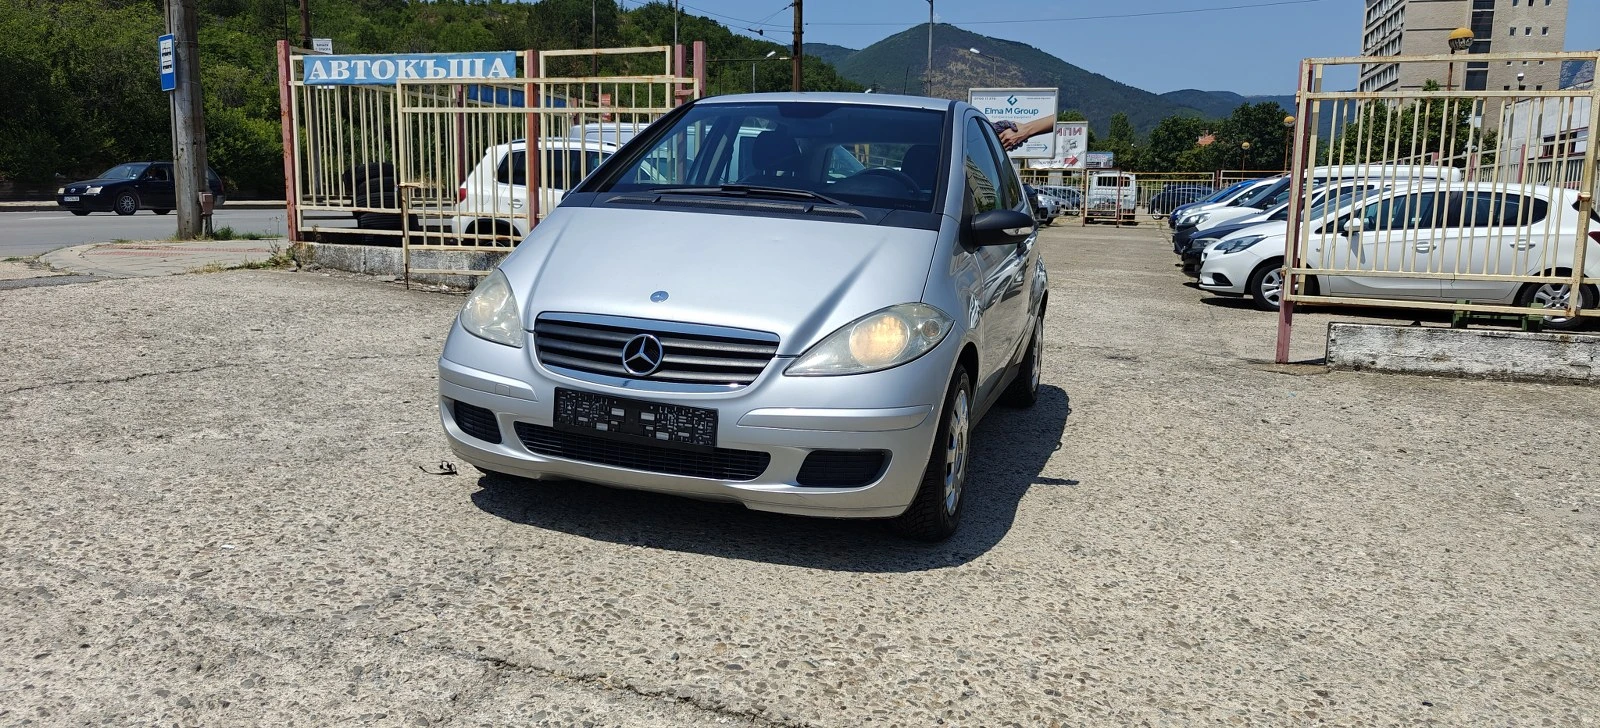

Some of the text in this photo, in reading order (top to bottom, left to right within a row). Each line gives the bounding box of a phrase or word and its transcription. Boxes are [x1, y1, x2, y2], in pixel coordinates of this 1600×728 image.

[984, 107, 1039, 116] Elma M Group
